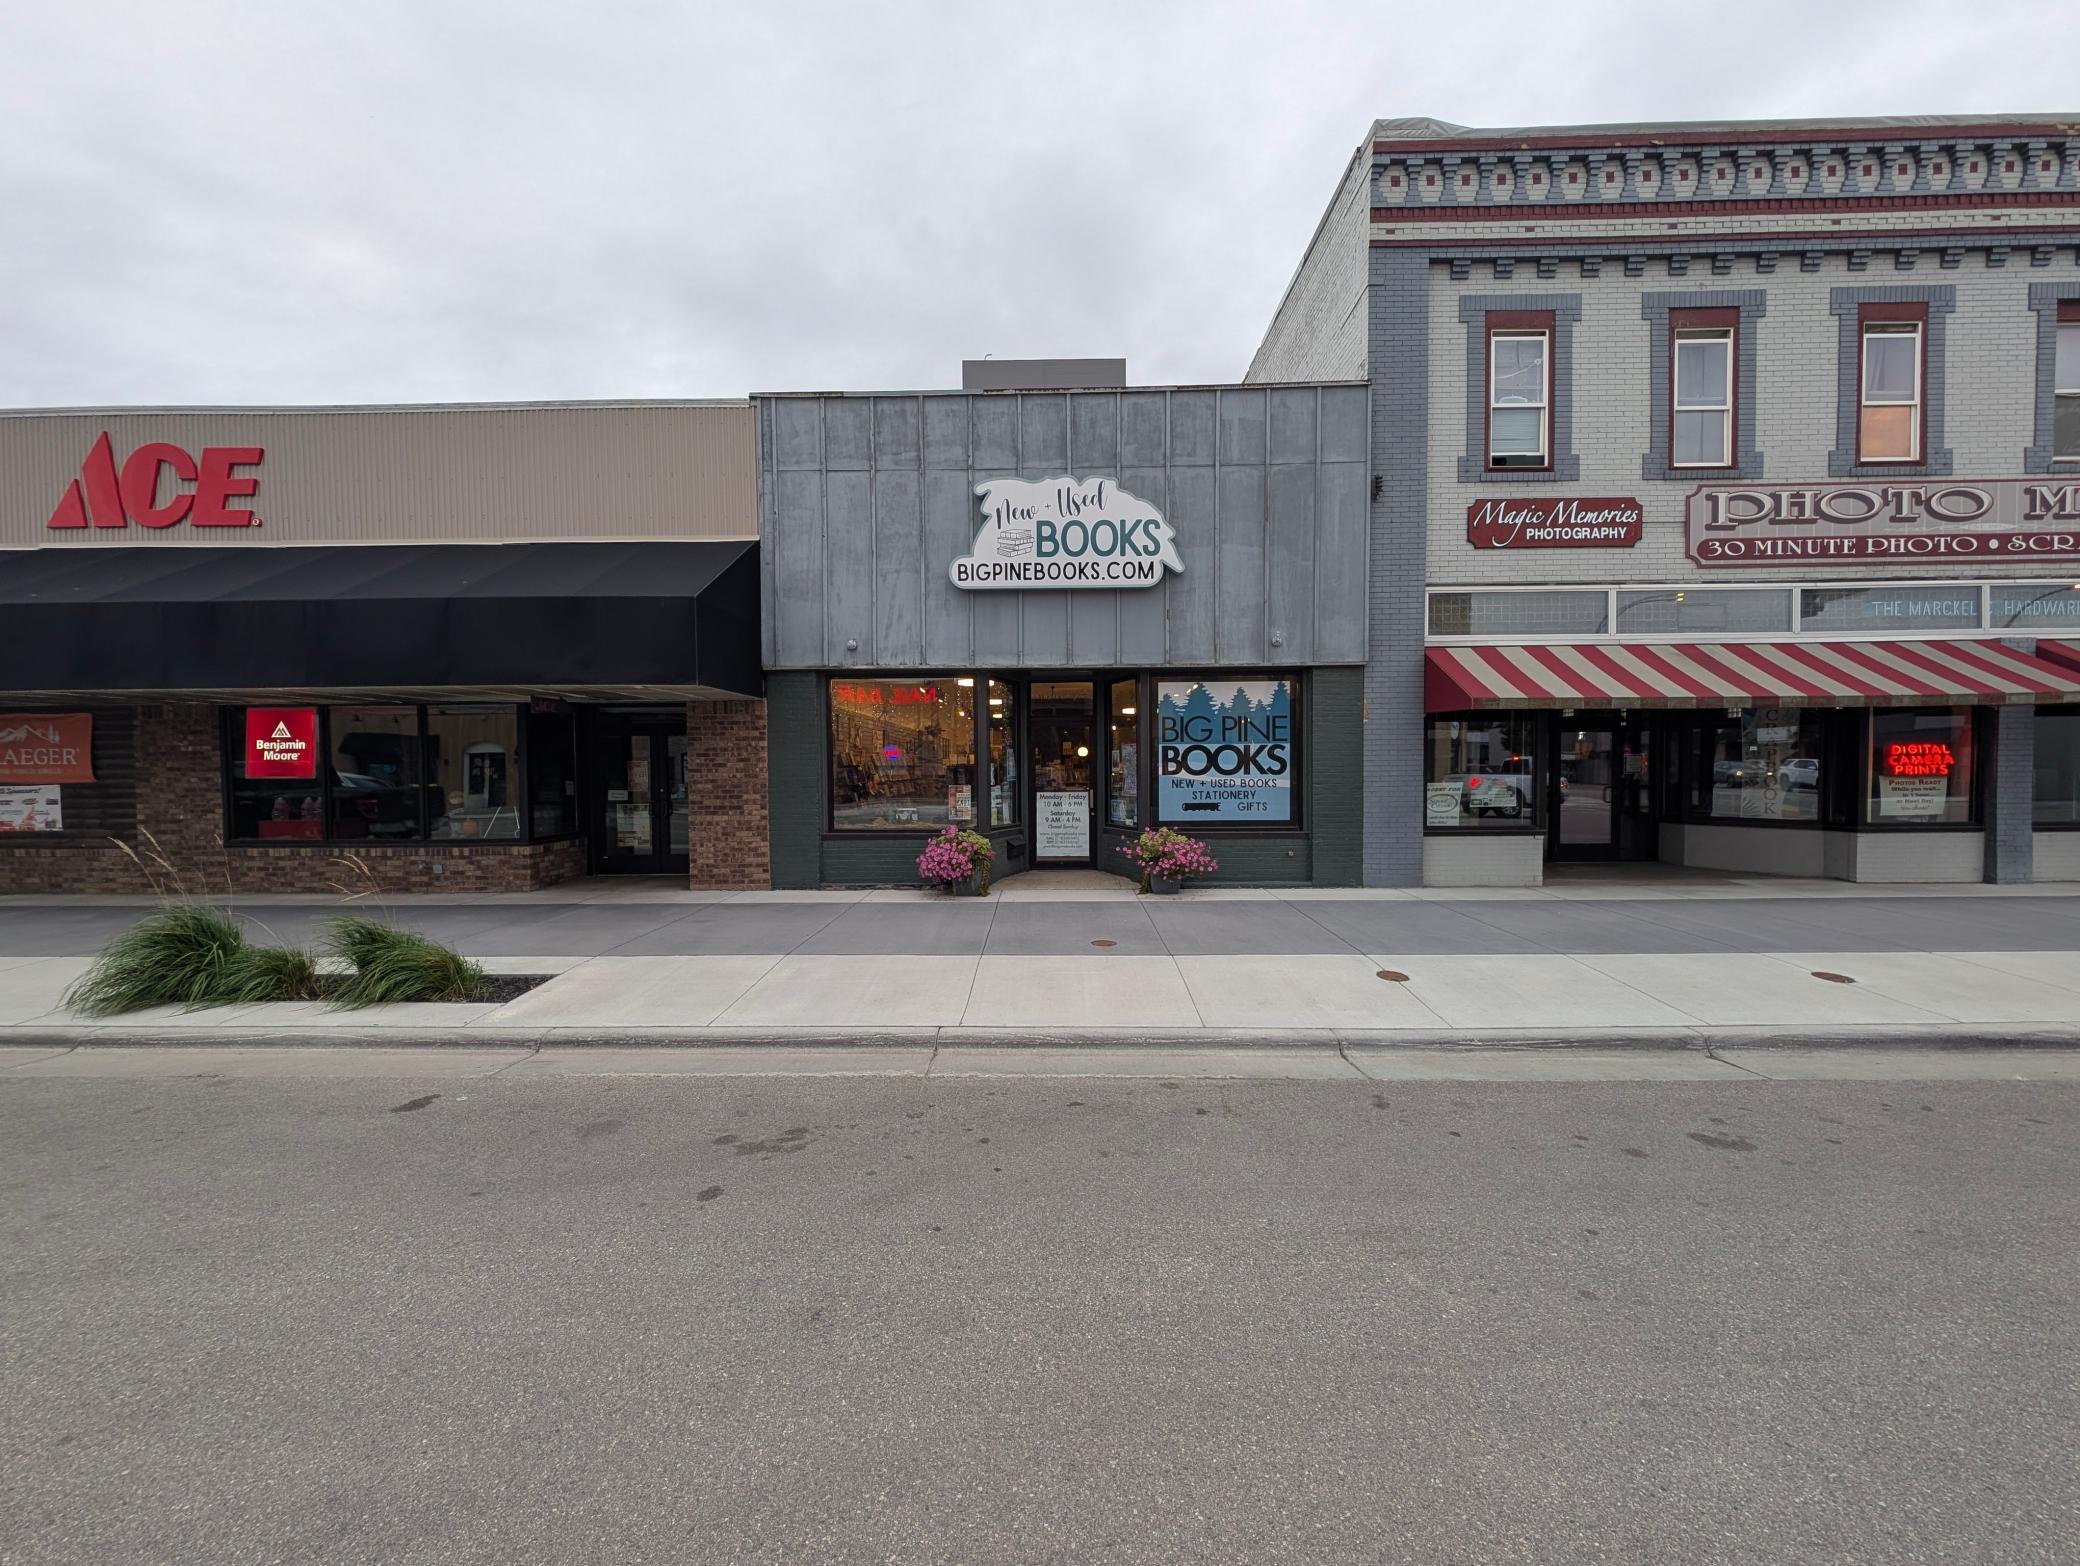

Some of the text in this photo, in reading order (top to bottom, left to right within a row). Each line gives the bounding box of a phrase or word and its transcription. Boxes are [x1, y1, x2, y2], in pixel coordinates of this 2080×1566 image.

[47, 431, 264, 529] ACE
[996, 498, 1039, 529] New
[1057, 480, 1108, 518] Used
[1705, 486, 1994, 530] PHOTO
[1473, 500, 1638, 547] Magic Memories
[1036, 518, 1161, 558] BOOKS
[1526, 527, 1627, 540] PHOTOGRAPHY
[1707, 540, 1745, 556] 30
[1752, 538, 1856, 556] MINUTE
[1865, 536, 1978, 554] PHOTO
[2007, 533, 2080, 551] SCR
[957, 560, 1155, 582] BIGPINEBOOKS.COM
[1871, 600, 1902, 616] THE
[1161, 715, 1288, 743] BIG PINE
[256, 739, 305, 752] Benjamin
[1890, 744, 1950, 755] DIGITAL
[0, 747, 77, 766] AEGER
[263, 751, 299, 761] Moore
[1161, 743, 1288, 776] BOOKS
[1888, 755, 1954, 765] CAMERA
[1895, 765, 1949, 775] PRINTS
[1171, 779, 1195, 789] NEW
[1210, 778, 1236, 788] USED
[1240, 778, 1277, 788] BOOKS
[1192, 790, 1257, 800] STATIONERY
[1237, 801, 1268, 811] GIFTS
